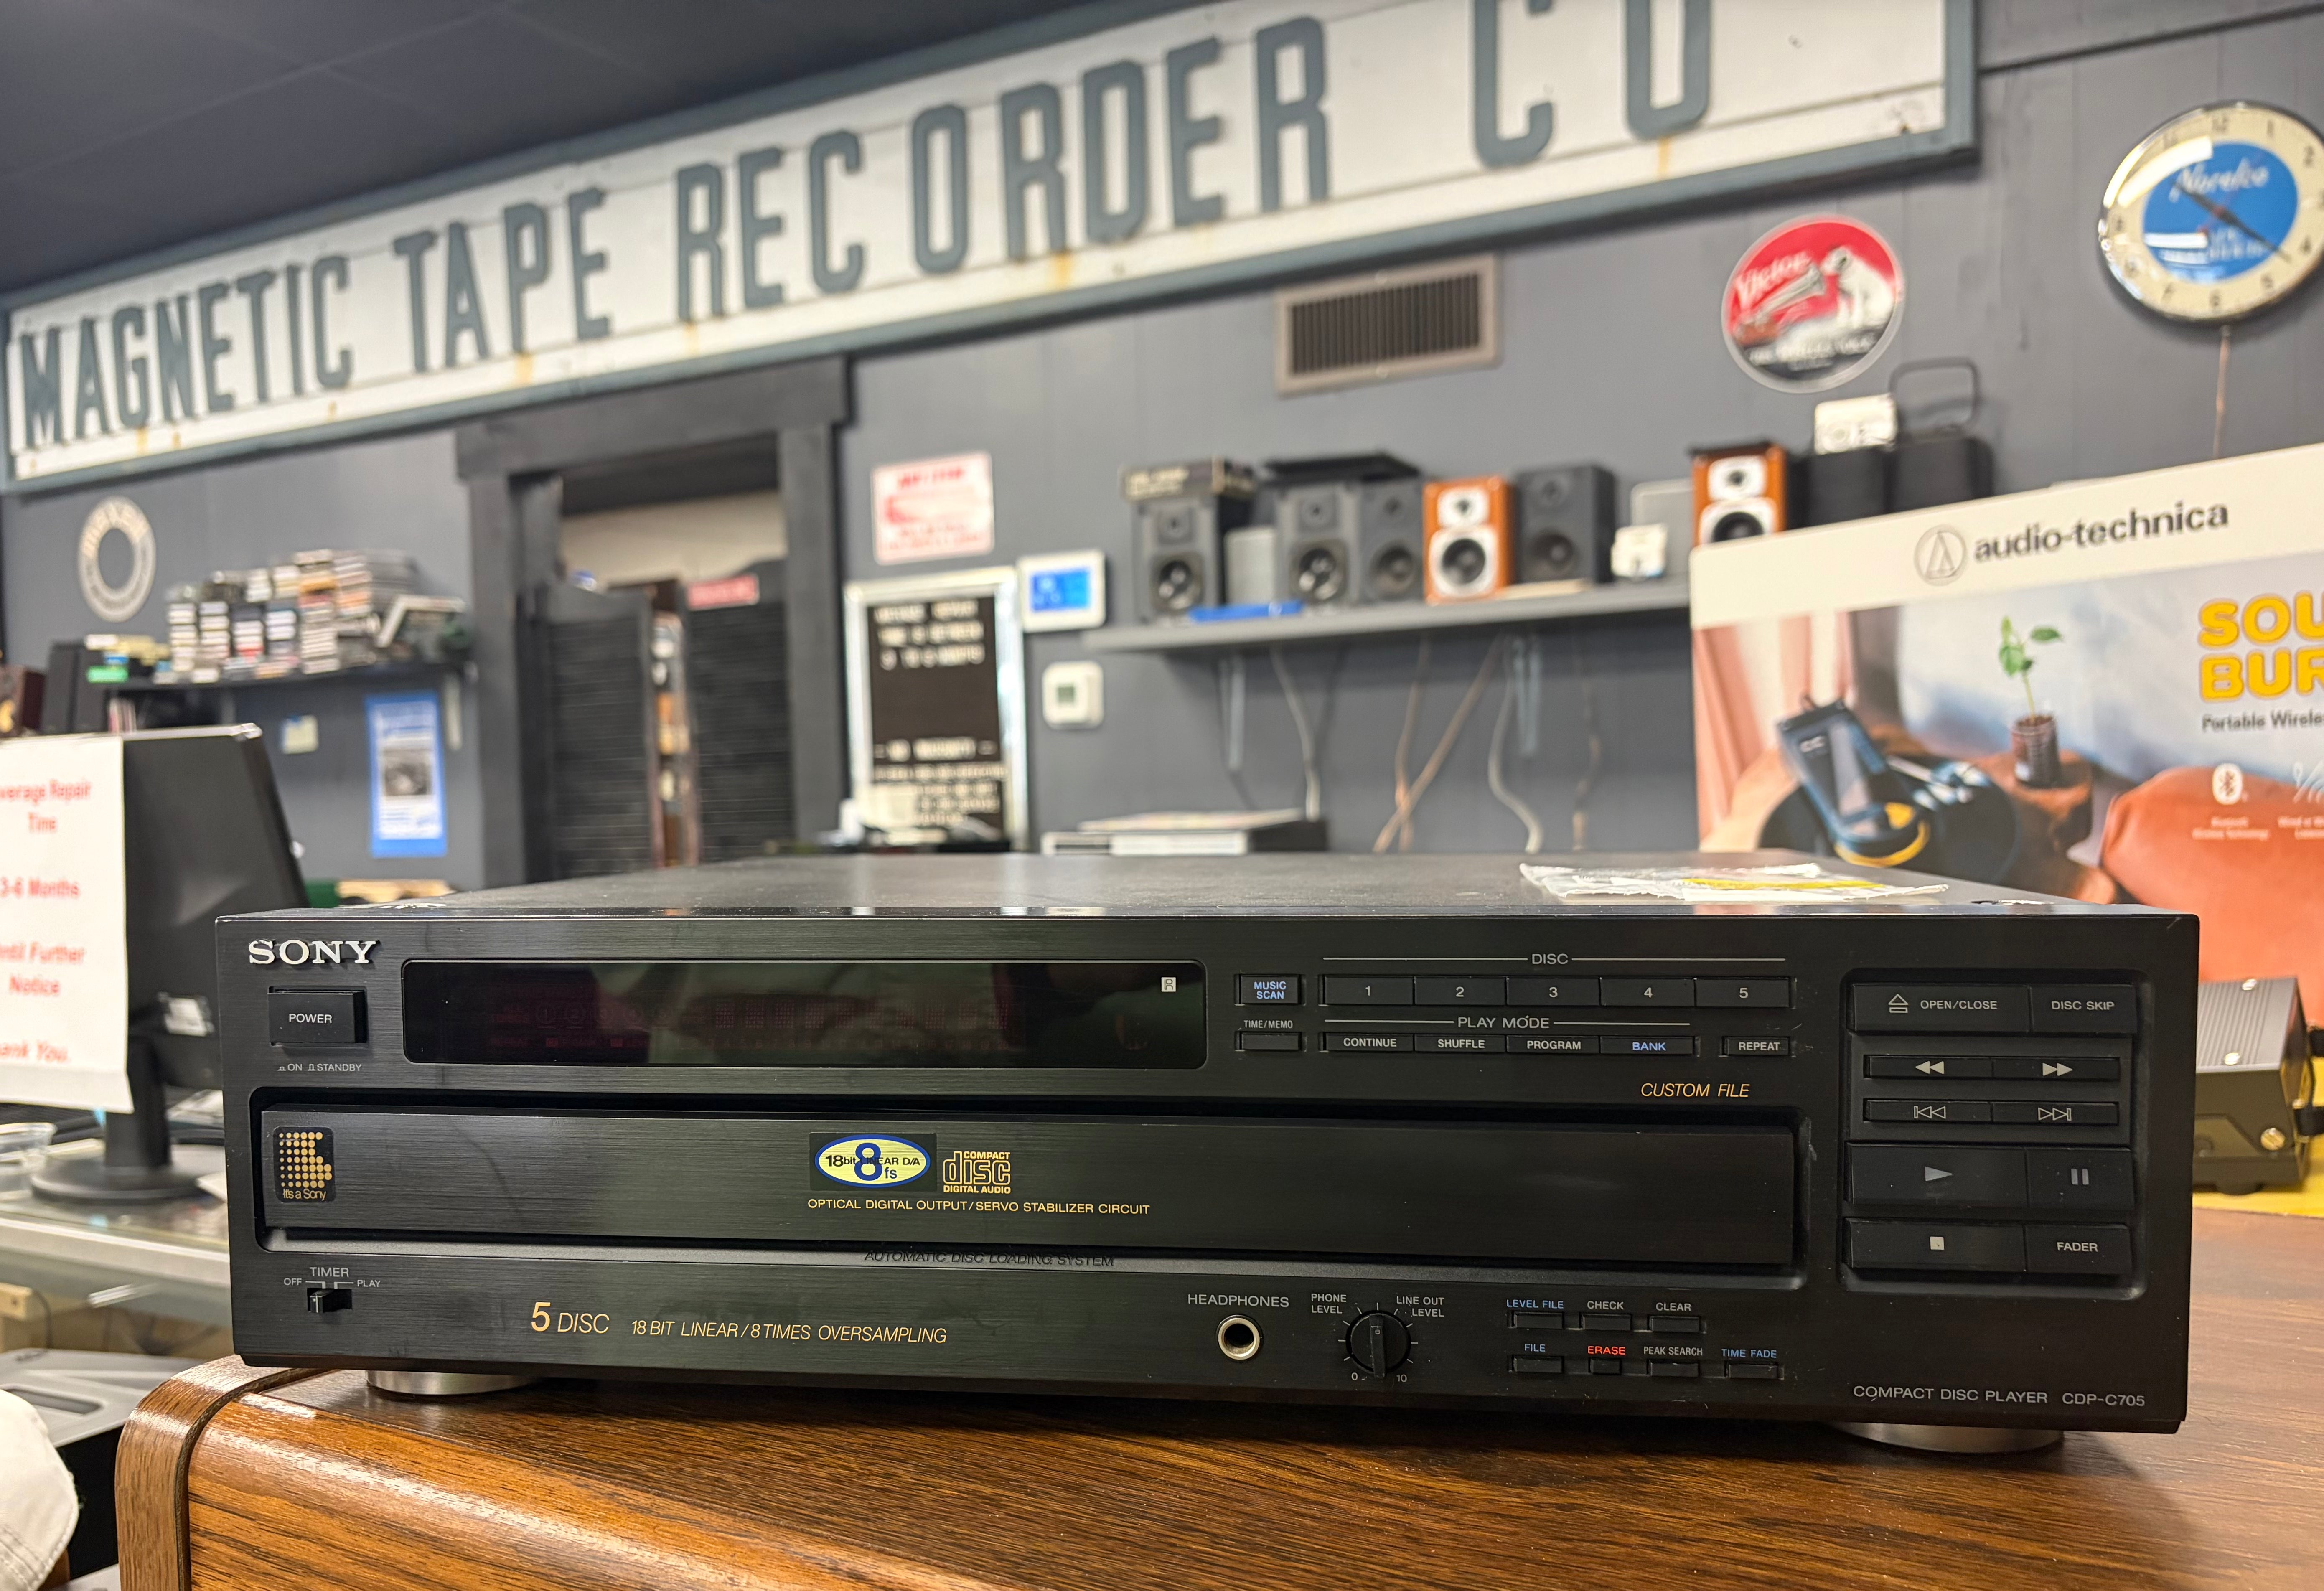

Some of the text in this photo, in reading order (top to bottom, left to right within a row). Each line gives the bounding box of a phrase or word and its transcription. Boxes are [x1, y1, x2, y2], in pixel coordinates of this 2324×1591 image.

[19, 256, 352, 450] MAGNETIC
[393, 187, 612, 373] TAPE
[676, 15, 1329, 322] RECORDER
[1975, 501, 2229, 563] audio-technica
[2201, 712, 2267, 733] Portable
[49, 779, 91, 803] Repair
[28, 812, 57, 833] Time
[28, 878, 81, 897] Months
[29, 941, 86, 963] Further
[249, 940, 376, 965] SONY
[1532, 954, 1569, 965] DISC
[10, 974, 60, 996] Notice
[1254, 981, 1287, 990] MUSIC
[1256, 991, 1284, 1000] SCAN
[1365, 986, 1371, 996] 1
[1455, 986, 1464, 997] 2
[1549, 986, 1558, 998] 3
[1644, 987, 1653, 998] 4
[1739, 987, 1749, 999] 5
[1920, 1000, 1998, 1010] OPEN/CLOSE
[2051, 1001, 2115, 1011] DISC SKIP
[289, 1013, 333, 1024] POWER
[1458, 1017, 1549, 1029] PLAY MODE
[1243, 1020, 1293, 1029] TIME/MEMO
[1343, 1038, 1397, 1047] CONTINUE
[1437, 1039, 1485, 1049] SHUFFLE
[1526, 1040, 1581, 1050] PROGRAM
[1632, 1042, 1666, 1052] BANK
[1739, 1042, 1780, 1051] REPEAT
[317, 1063, 362, 1072] STANDBY
[1641, 1083, 1750, 1098] CUSTOM FILE
[964, 1151, 1011, 1160] COMPACT
[854, 1142, 883, 1182] 8
[903, 1157, 920, 1166] D/A
[884, 1167, 897, 1179] fs
[943, 1151, 1011, 1186] disc
[295, 1190, 302, 1199] a
[303, 1188, 326, 1201] Sony
[808, 1198, 861, 1209] OPTICAL
[866, 1199, 913, 1210] DIGITAL
[1023, 1202, 1093, 1213] STABILIZER
[1098, 1203, 1150, 1214] CIRCUIT
[2057, 1241, 2098, 1253] FADER
[863, 1250, 1115, 1266] AUTOMATIC DISC LOADING SYSTEM
[309, 1267, 349, 1278] TIMER
[1187, 1294, 1290, 1308] HEADPHONES
[1310, 1293, 1347, 1303] PHONE
[1396, 1296, 1444, 1306] LINE OUT
[1310, 1304, 1343, 1314] LEVEL
[1506, 1299, 1564, 1309] LEVEL FILE
[1587, 1300, 1624, 1310] CHECK
[1655, 1302, 1691, 1311] CLEAR
[531, 1301, 610, 1334] 5 DISC
[1411, 1308, 1444, 1317] LEVEL
[631, 1320, 646, 1335] 18
[650, 1320, 675, 1336] BIT
[818, 1325, 947, 1343] OVERSAMPLING
[1524, 1343, 1546, 1352] FILE
[1588, 1346, 1625, 1355] ERASE
[1643, 1346, 1703, 1356] PEAK SEARCH
[1721, 1348, 1777, 1358] TIME FADE
[1351, 1372, 1358, 1381] 0
[1853, 1385, 2145, 1407] COMPACT DISC PLAYER CDP-C705
